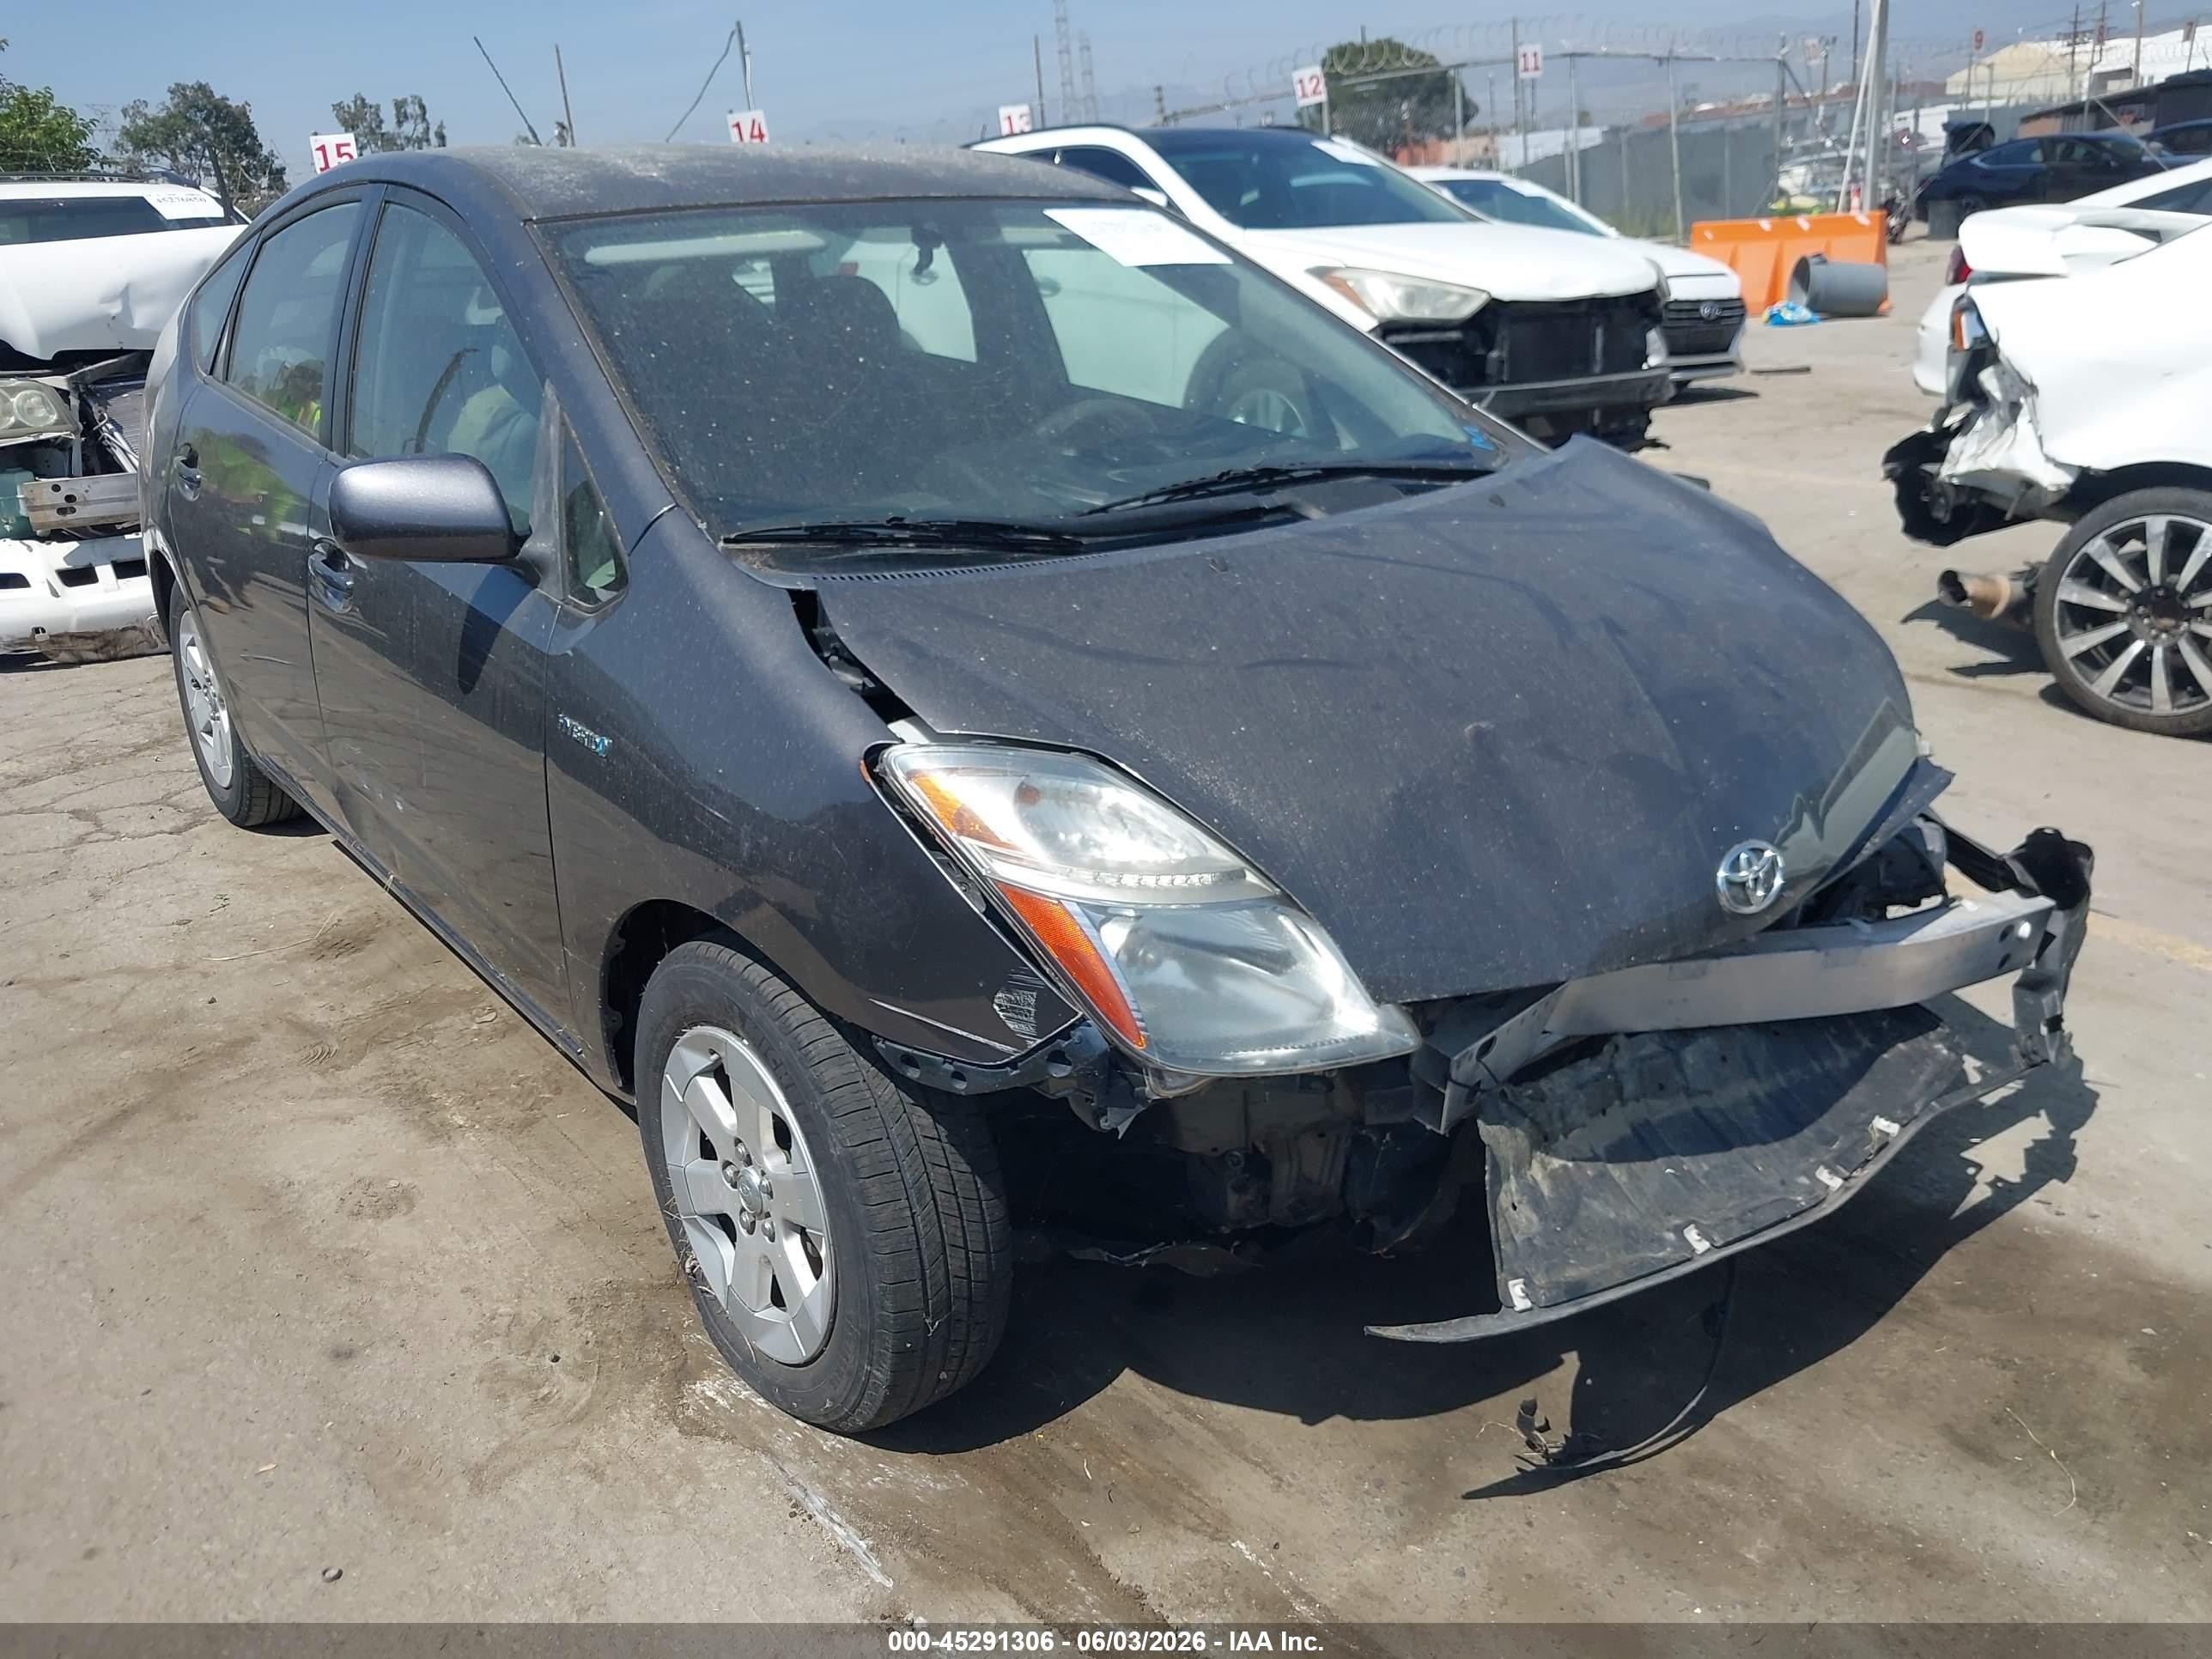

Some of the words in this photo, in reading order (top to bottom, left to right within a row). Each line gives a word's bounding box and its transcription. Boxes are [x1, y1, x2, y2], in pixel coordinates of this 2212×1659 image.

[1520, 51, 1540, 73] 11
[1297, 74, 1322, 98] 12
[732, 118, 765, 143] 14
[315, 143, 354, 173] 15
